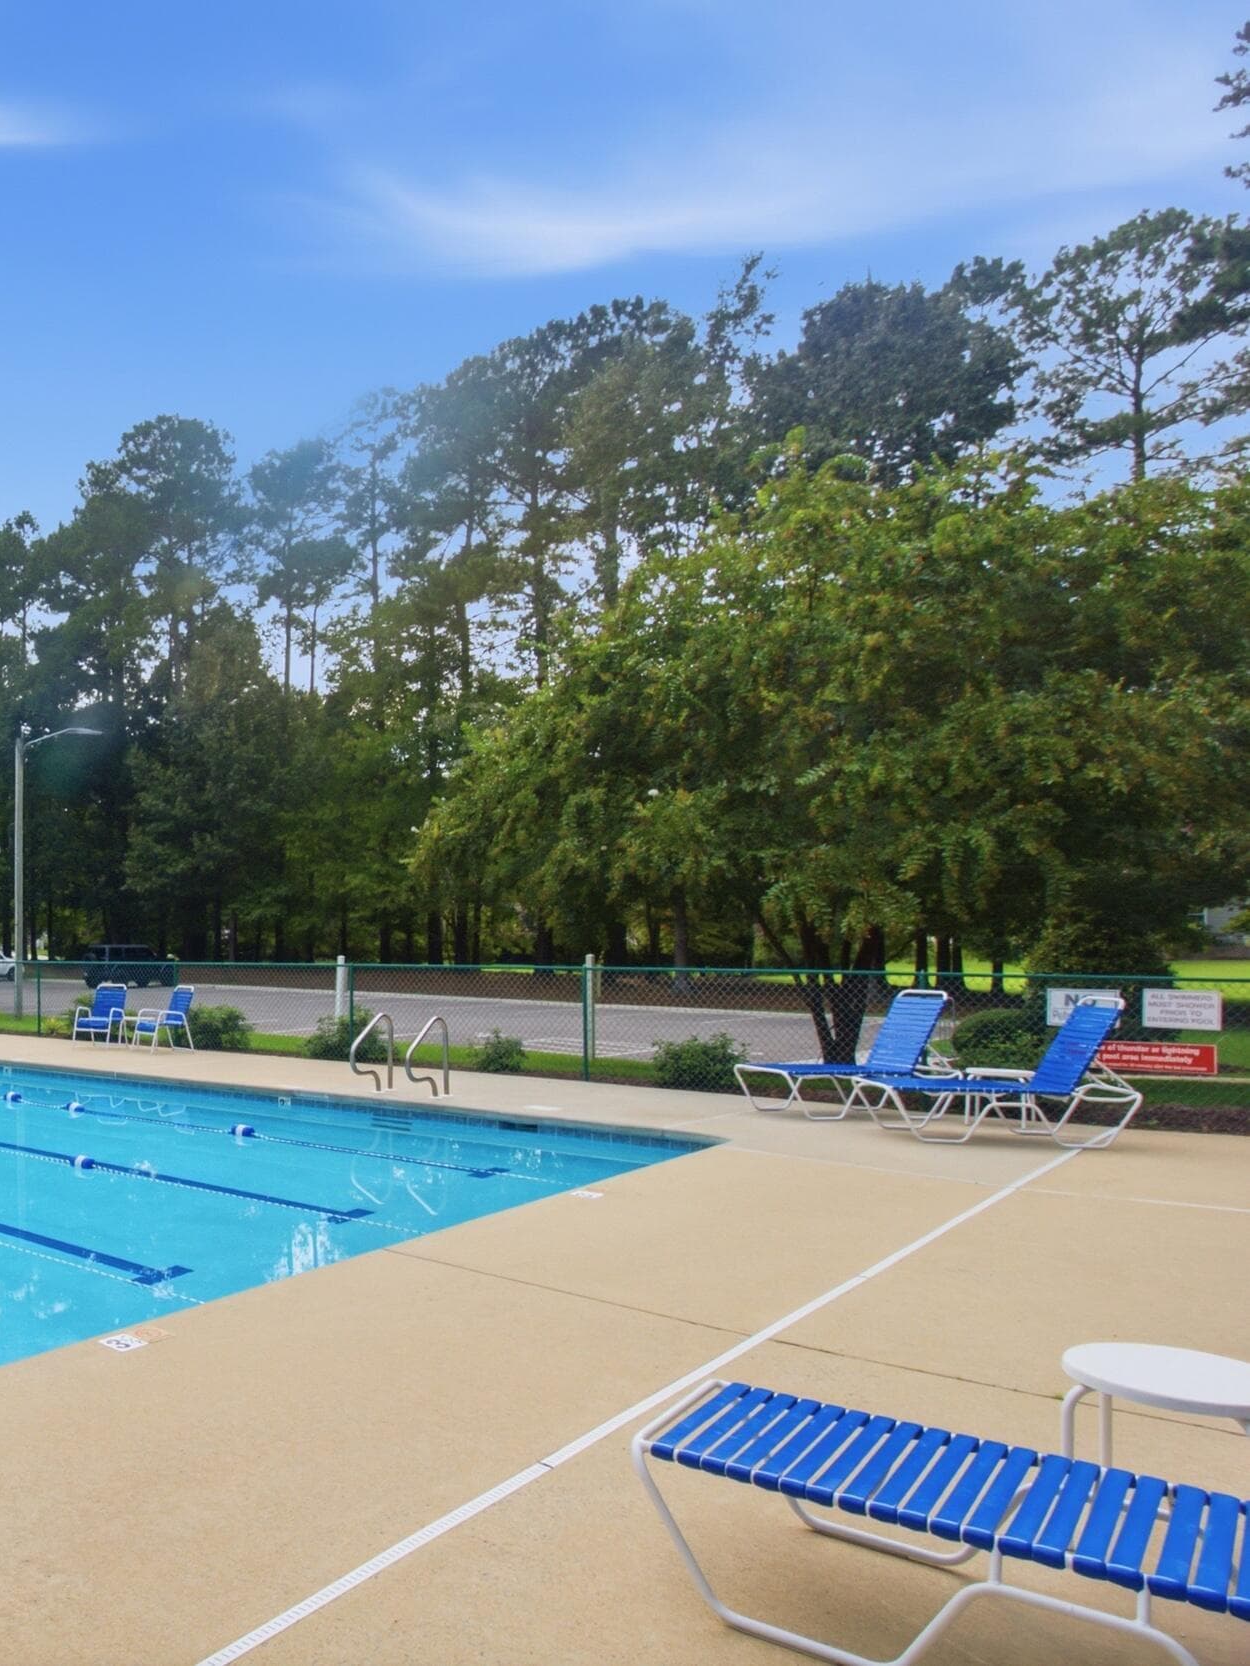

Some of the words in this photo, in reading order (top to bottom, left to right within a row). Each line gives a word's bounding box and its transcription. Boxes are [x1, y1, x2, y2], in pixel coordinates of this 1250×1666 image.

[1147, 1016, 1189, 1024] ENTERING
[1191, 1018, 1215, 1026] POOL
[1117, 1044, 1149, 1052] thunder
[1161, 1046, 1200, 1057] lightning
[1102, 1053, 1120, 1061] pool
[1140, 1054, 1193, 1065] immediately
